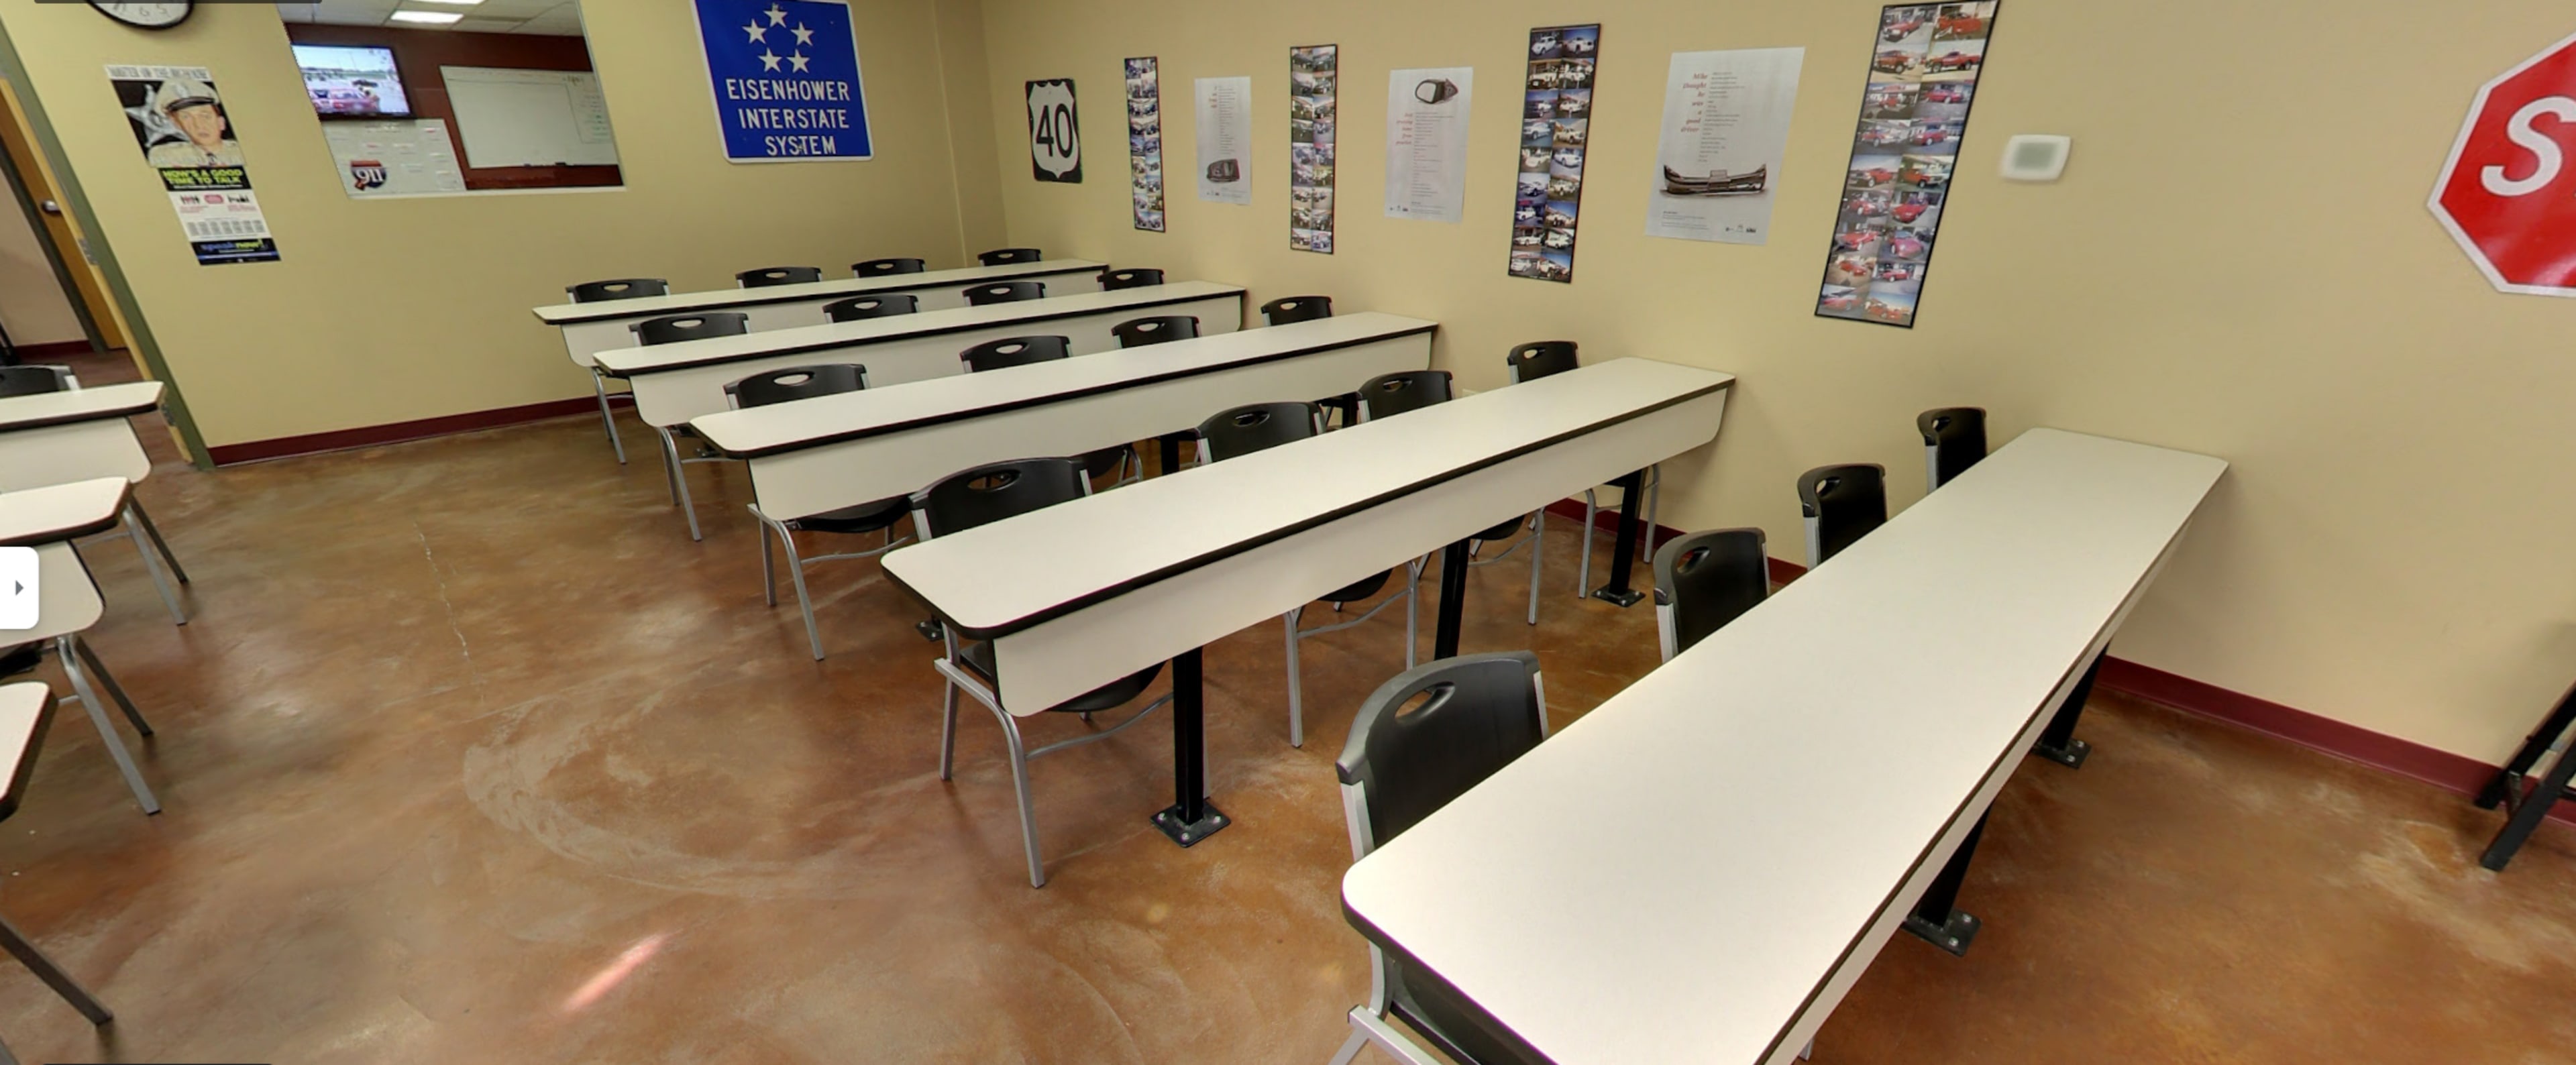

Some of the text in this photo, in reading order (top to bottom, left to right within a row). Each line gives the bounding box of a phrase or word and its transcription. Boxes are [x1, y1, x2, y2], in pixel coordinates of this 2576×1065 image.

[725, 78, 850, 101] EISENHOWER
[737, 108, 850, 129] INTERSTATE
[1036, 103, 1073, 158] 40
[764, 135, 837, 156] SYSTEM
[355, 168, 384, 184] 911
